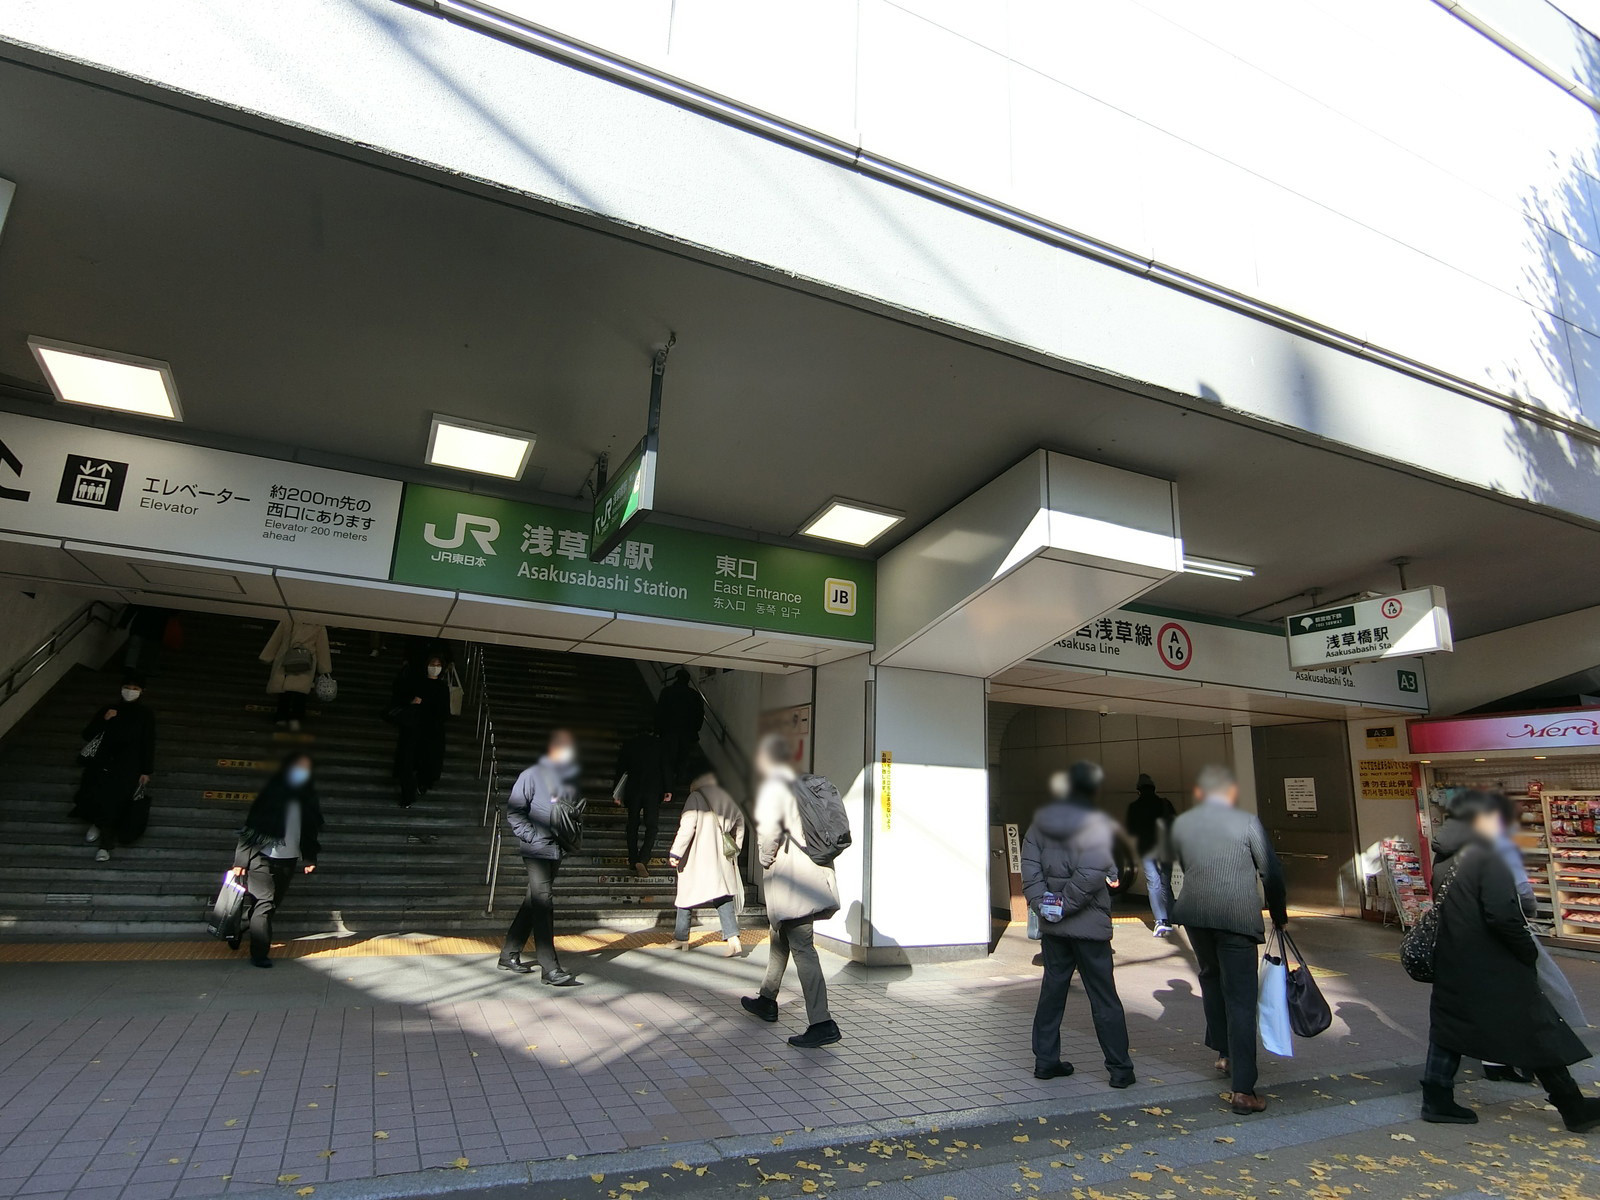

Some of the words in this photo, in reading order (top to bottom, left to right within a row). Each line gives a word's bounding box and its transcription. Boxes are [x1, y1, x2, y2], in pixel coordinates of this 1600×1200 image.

[142, 477, 251, 505] エレベーター
[269, 484, 371, 512] 約200m先の
[140, 497, 199, 515] Elevator
[267, 501, 376, 530] 西口にあります
[262, 531, 296, 542] ahead
[265, 519, 308, 533] Elevator
[311, 526, 330, 536] 200
[333, 530, 368, 542] meters
[424, 513, 500, 556] JR
[431, 551, 486, 567] JR東日本
[715, 555, 758, 581] 東口
[517, 562, 629, 592] Asakusabashi
[633, 578, 688, 600] Station
[713, 580, 743, 595] East
[747, 585, 802, 603] Entrance
[832, 590, 849, 604] JB
[713, 597, 746, 611] 东入口
[756, 603, 776, 615] 동쪽
[781, 607, 800, 618] 입구
[1170, 631, 1179, 644] A
[1326, 627, 1389, 649] 浅草橋駅
[1100, 643, 1120, 655] Line
[1168, 645, 1184, 660] 16
[1326, 644, 1377, 658] Asakusabashi
[1295, 671, 1341, 686] Asakusabashi
[1342, 677, 1356, 688] Sta.
[1400, 674, 1416, 690] A3
[1373, 729, 1387, 737] A3
[1506, 718, 1599, 738] Merci
